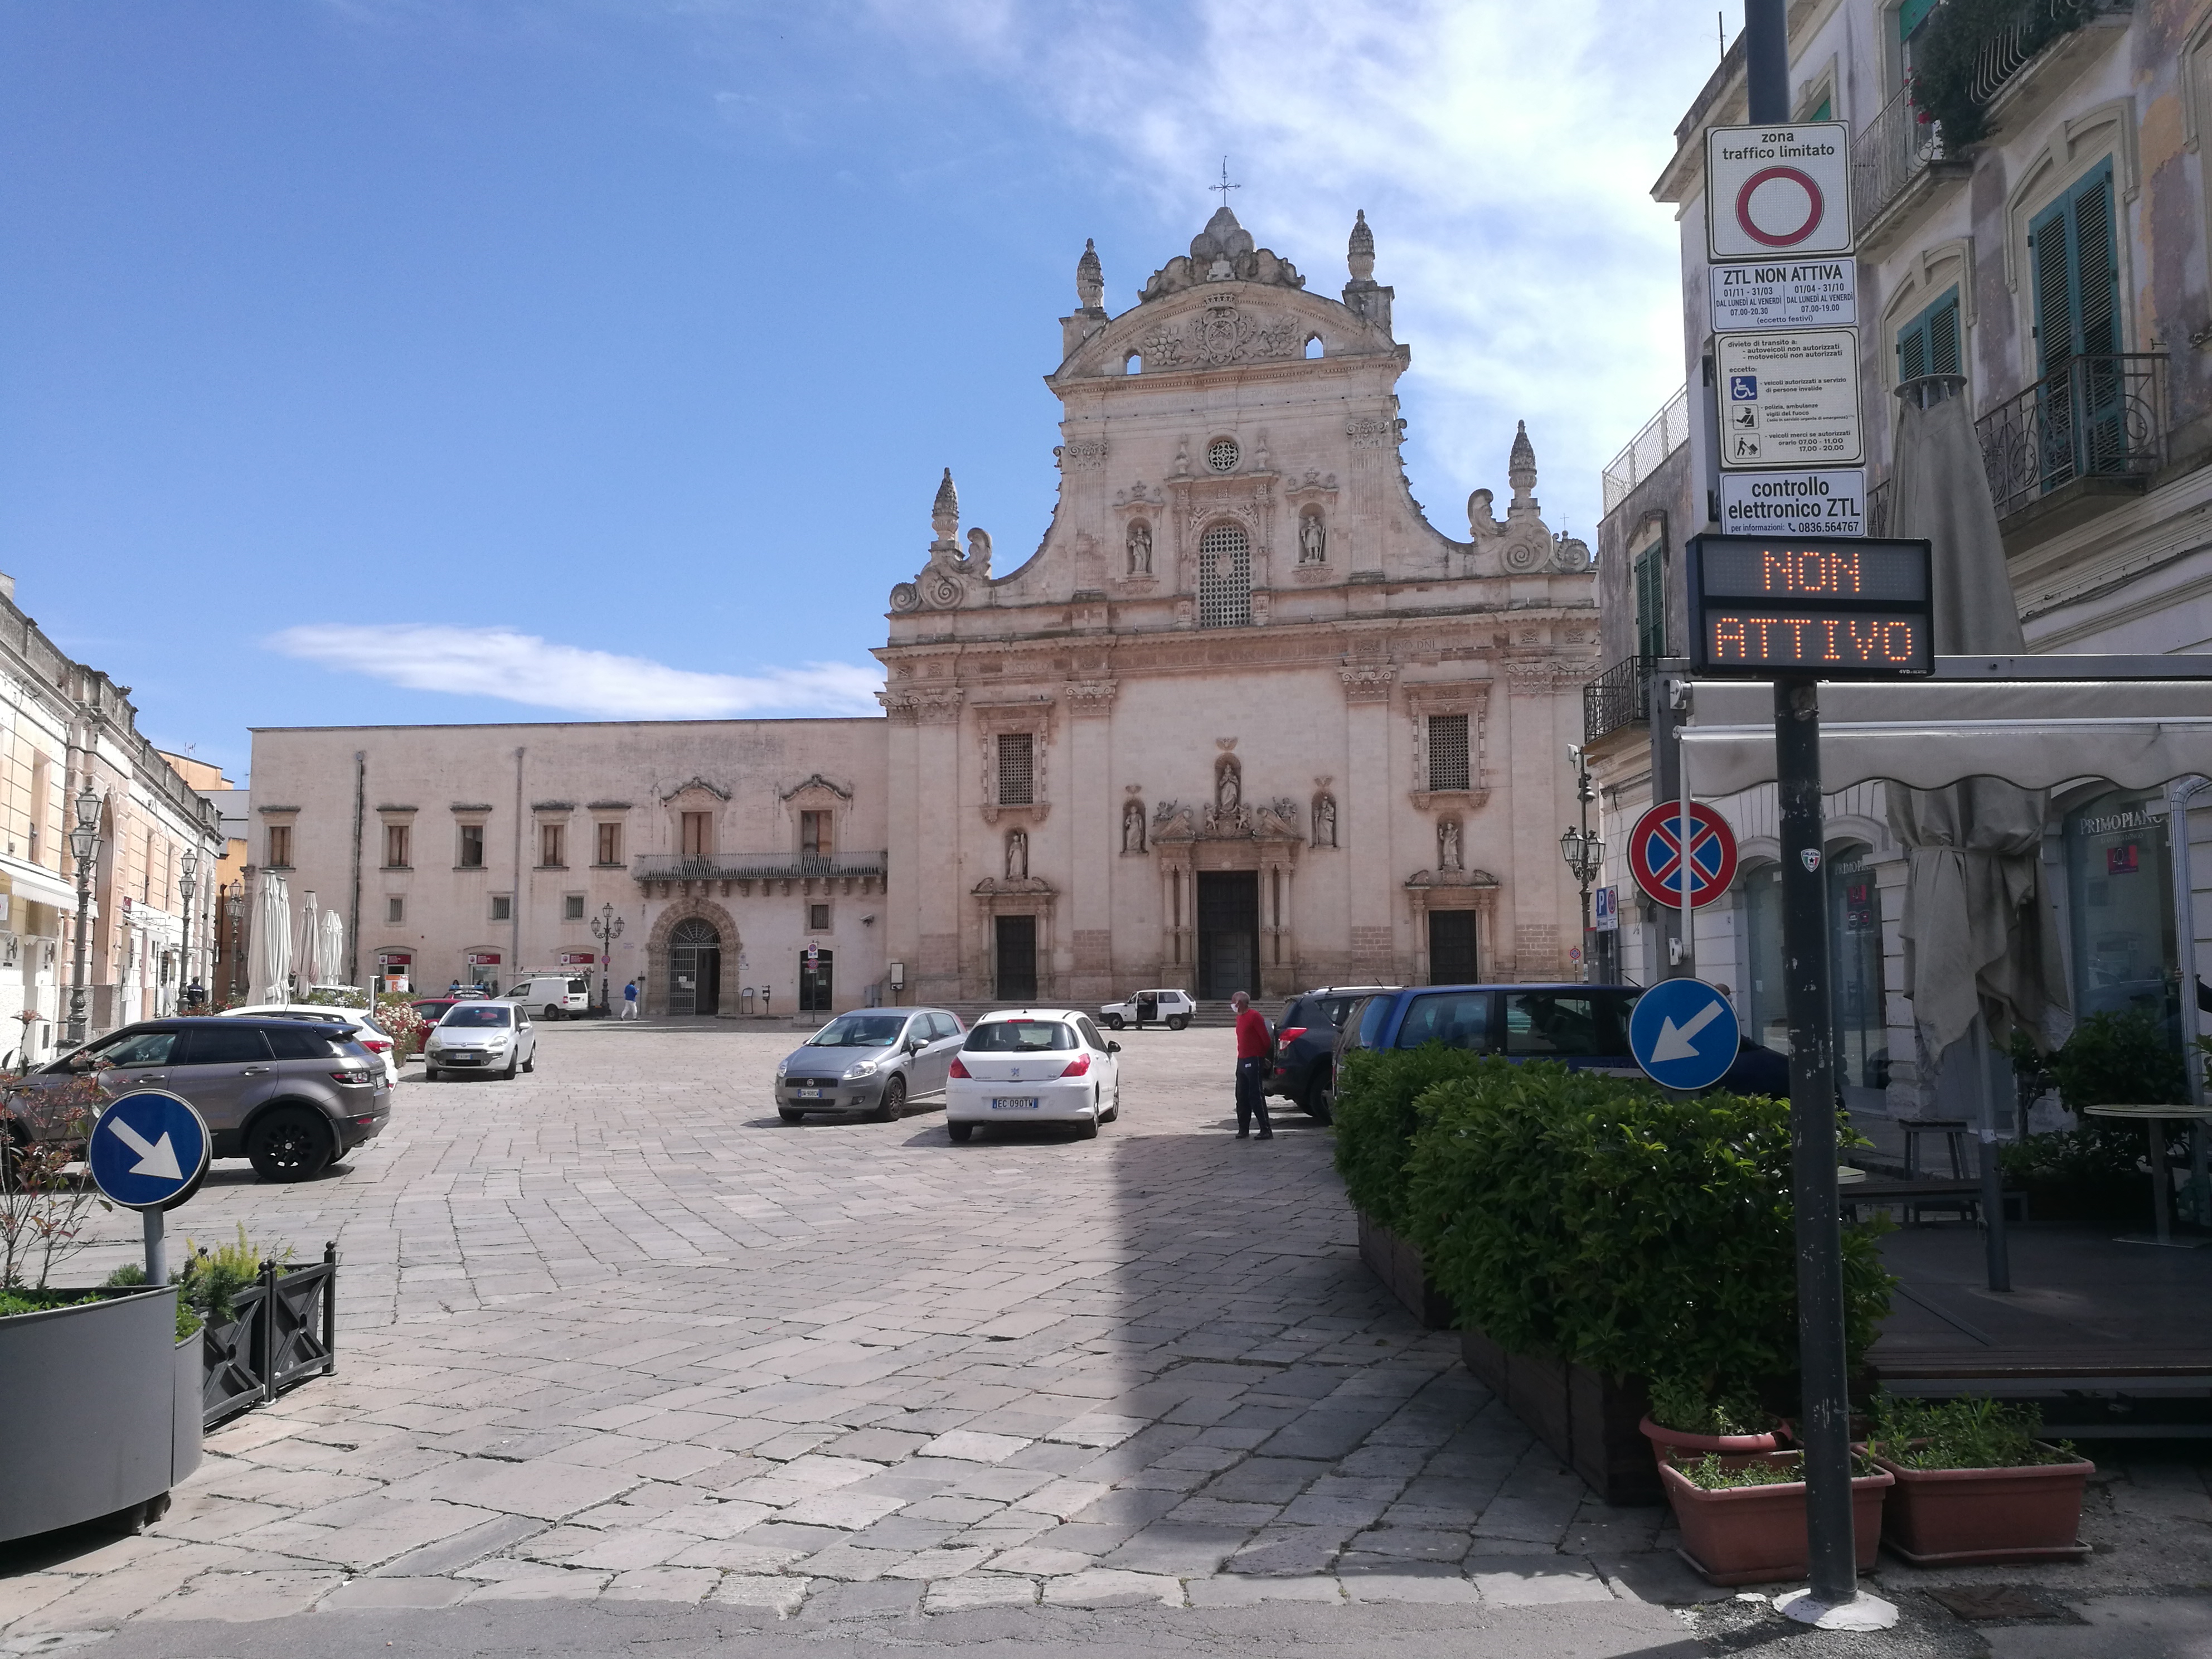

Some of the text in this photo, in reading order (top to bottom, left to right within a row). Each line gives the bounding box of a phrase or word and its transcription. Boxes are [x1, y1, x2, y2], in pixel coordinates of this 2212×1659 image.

[1762, 132, 1794, 143] zona
[1723, 144, 1835, 160] traffico limitato
[1724, 264, 1843, 285] ZTL NON ATTIVA
[1724, 288, 1744, 297] 01/11
[1752, 287, 1773, 295] 31/03
[1794, 284, 1816, 293] 01/04
[1823, 283, 1844, 292] 31/10
[1728, 297, 1748, 307] LUNEDÌ
[1758, 295, 1782, 305] VENERDÌ
[1799, 293, 1820, 303] LUNEDÌ
[1829, 292, 1853, 301] VENERDÌ
[1801, 304, 1840, 312] 07.00-19.00
[1752, 476, 1830, 497] controllo
[1728, 497, 1860, 519] elettronico ZTL
[1731, 522, 1859, 533] per informazioni: 0836.564767
[1763, 551, 1860, 591] NON
[1716, 617, 1912, 661] ATTIVO
[1599, 891, 1604, 914] P
